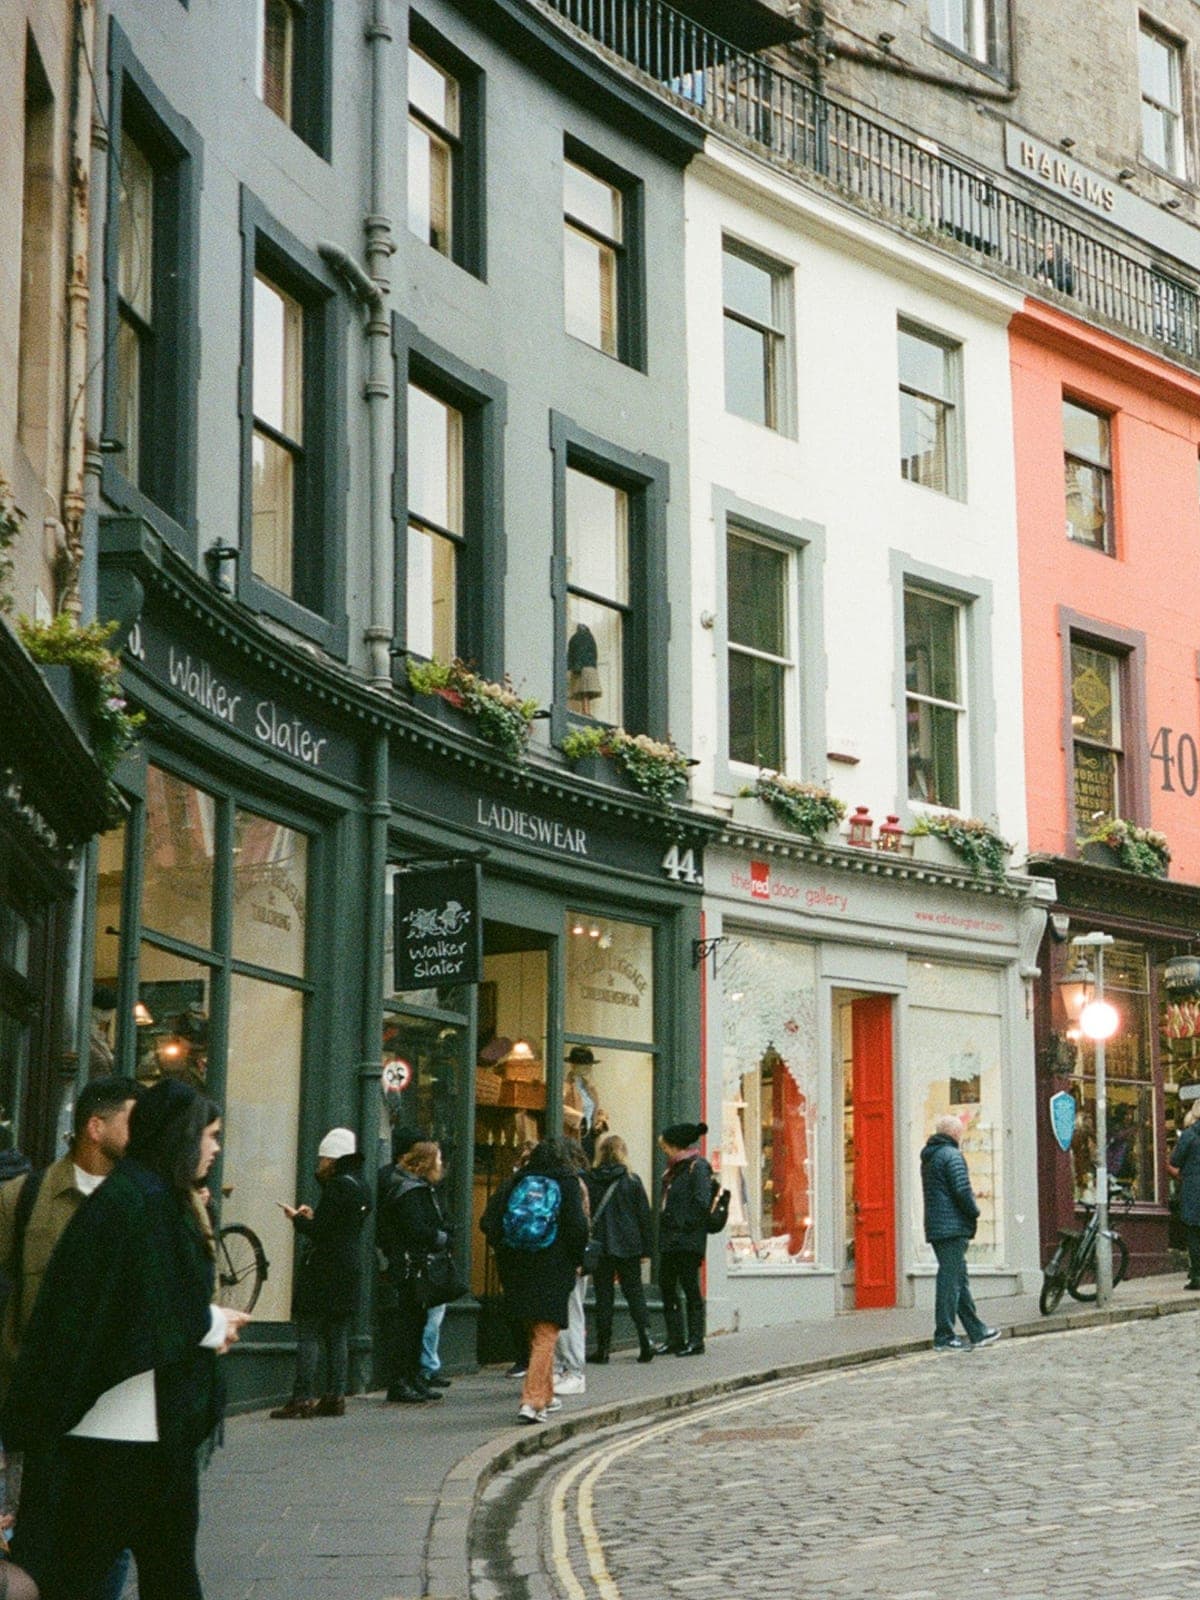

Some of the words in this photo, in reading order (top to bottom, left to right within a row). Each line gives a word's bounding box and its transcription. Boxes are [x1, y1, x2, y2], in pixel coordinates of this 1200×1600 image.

[1021, 141, 1114, 212] HANAMS
[169, 646, 241, 723] Walker
[255, 701, 327, 765] Slater
[1151, 727, 1198, 797] 40
[477, 798, 587, 855] LADIESWEAR
[752, 876, 769, 895] red
[772, 883, 799, 898] door
[805, 886, 848, 912] gallery
[414, 959, 464, 978] Slater
